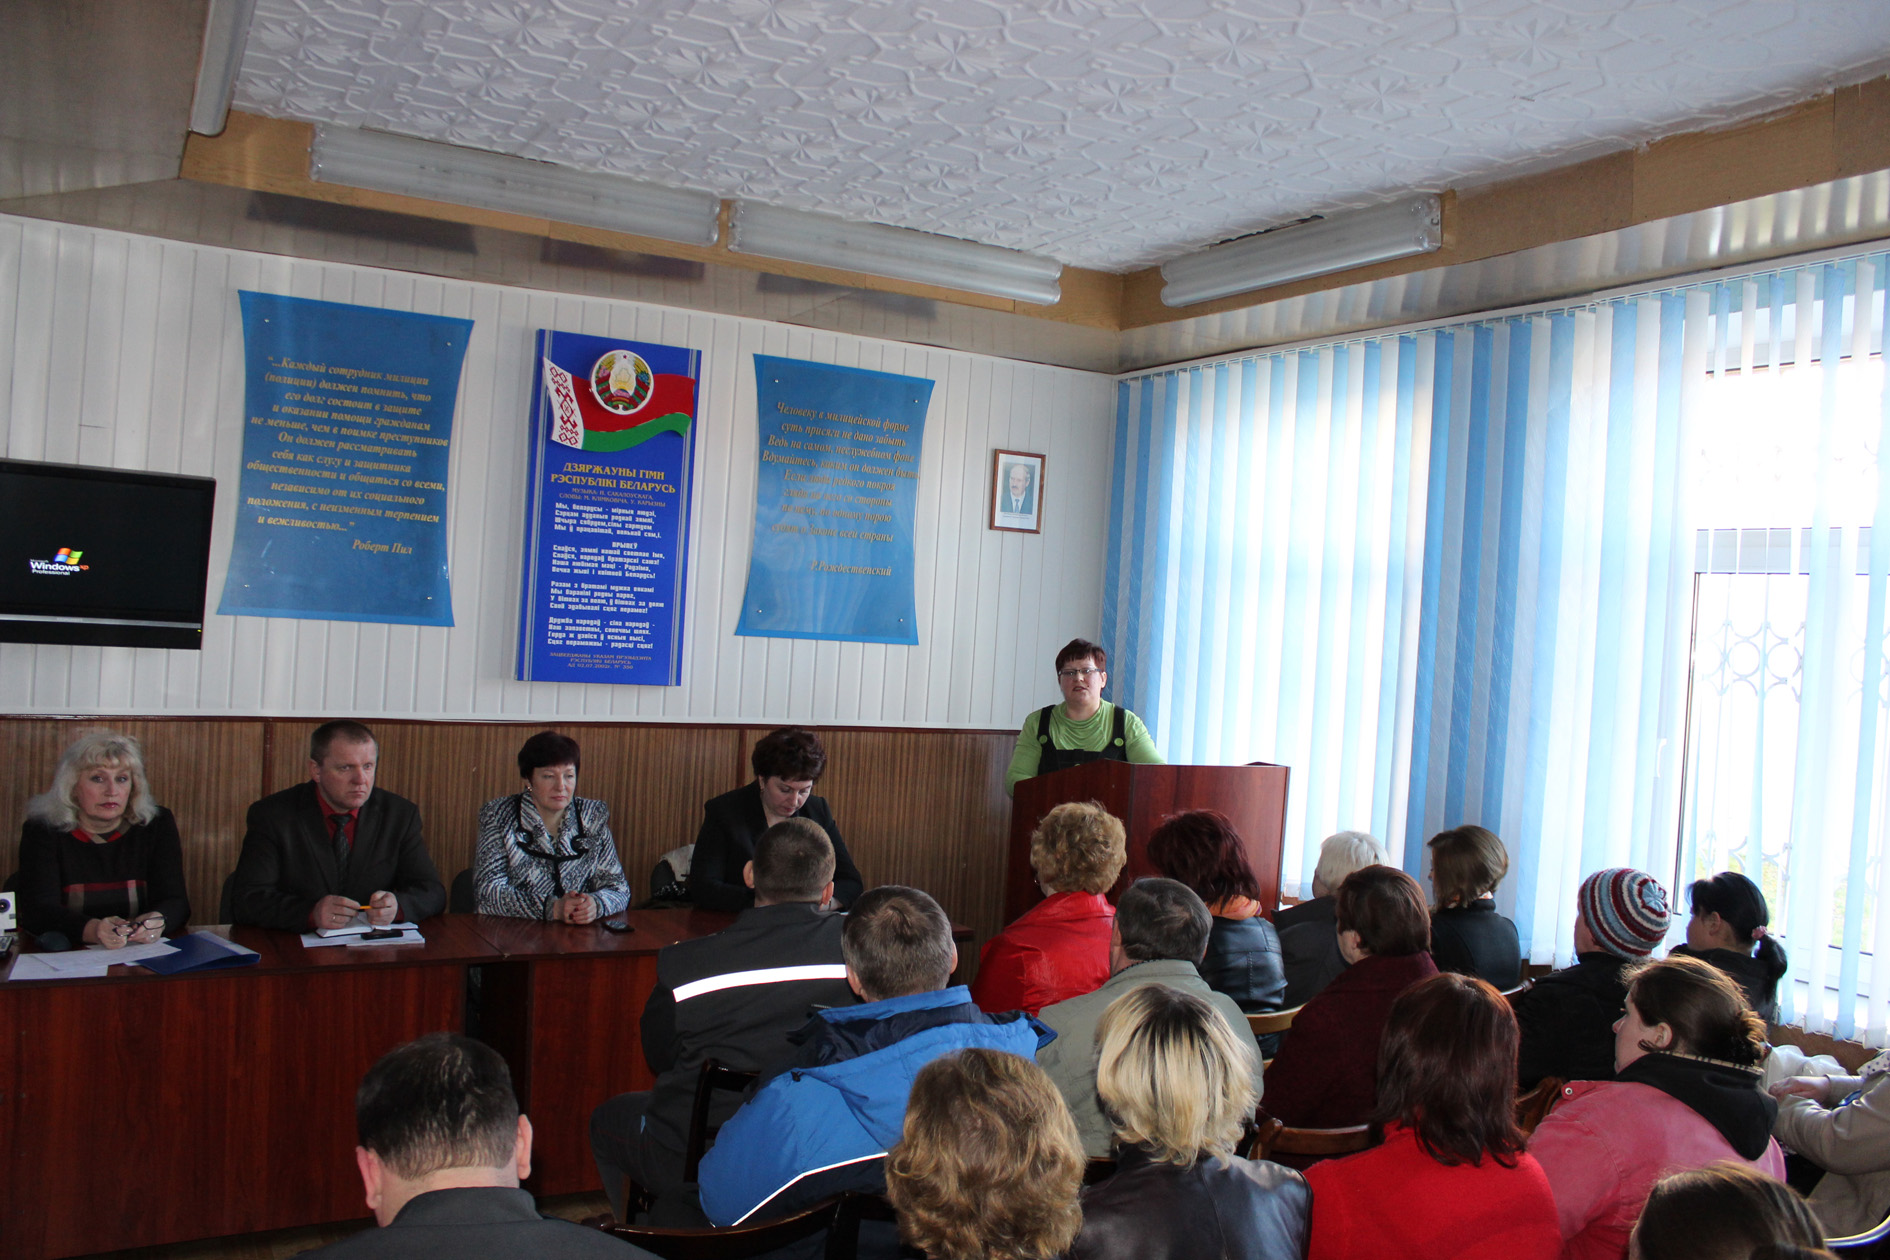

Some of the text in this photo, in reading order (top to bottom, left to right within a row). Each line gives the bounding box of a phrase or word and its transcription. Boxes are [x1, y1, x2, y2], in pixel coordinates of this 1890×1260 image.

[265, 372, 432, 402] (полиции) должен помнить, что
[328, 367, 383, 379] сотрудник
[384, 374, 429, 386] милиции
[284, 392, 301, 400] его
[302, 393, 325, 404] долг
[327, 398, 372, 409] состоит
[384, 405, 422, 415] защите
[281, 406, 329, 418] оказании
[331, 413, 372, 424] помощи
[374, 418, 431, 431] гражданам
[251, 417, 264, 425] не
[265, 419, 308, 431] меньше,
[312, 424, 330, 433] чем
[340, 428, 378, 438] поимке
[379, 432, 448, 446] преступников
[278, 432, 418, 457] Он должен рассматривать
[272, 449, 294, 460] себя
[296, 454, 314, 462] как
[316, 456, 342, 468] слугу
[354, 461, 412, 473] защитника
[247, 460, 337, 479] общественности
[348, 472, 400, 486] общаться
[414, 481, 444, 491] всеми,
[550, 474, 676, 493] РЭСПУБЛІКІ БЕЛАРУСЬ
[639, 470, 664, 480] ГІМН
[270, 483, 425, 505] независимо от их социального
[247, 497, 309, 510] положения,
[319, 504, 383, 517] неизменным
[384, 510, 440, 523] терпением
[257, 516, 265, 524] и
[352, 539, 413, 554] Роберт Пил
[30, 561, 80, 572] Windows
